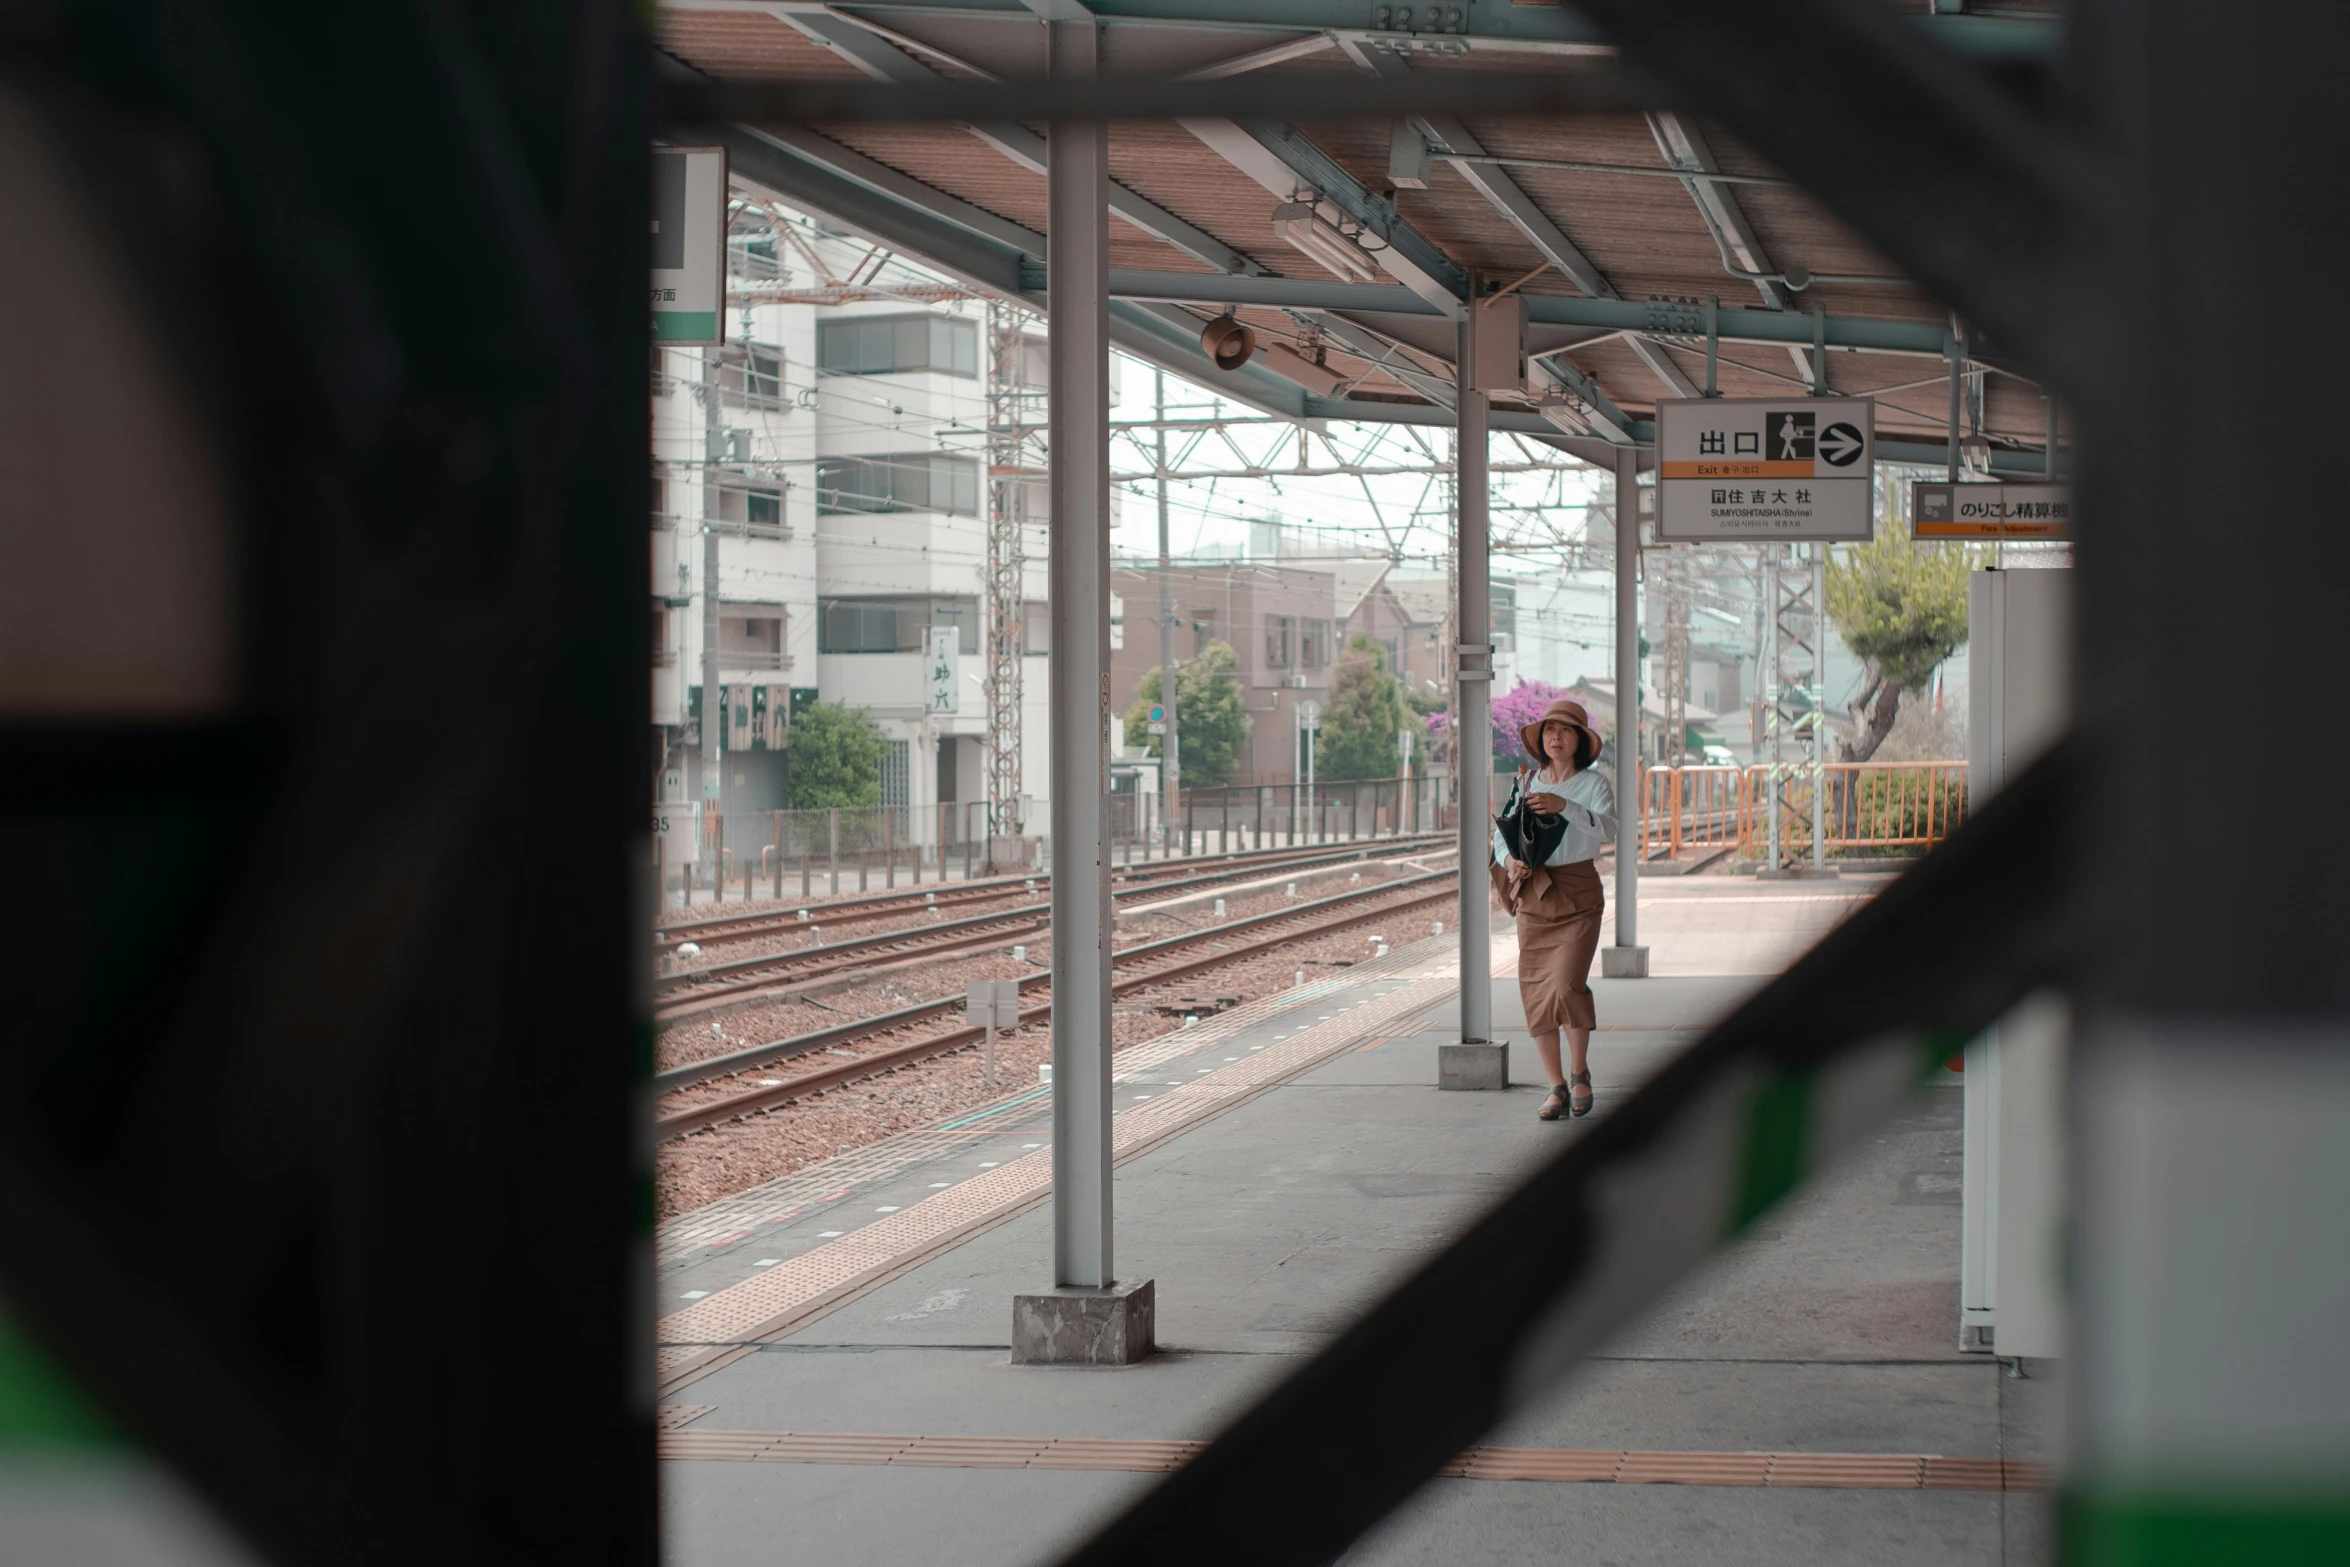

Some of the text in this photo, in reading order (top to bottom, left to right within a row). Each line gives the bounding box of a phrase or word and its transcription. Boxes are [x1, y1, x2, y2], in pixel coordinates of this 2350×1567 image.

[1700, 430, 1759, 455] 出口
[1698, 465, 1717, 475] Exit
[1728, 489, 1812, 504] 住吉大社
[1961, 502, 2070, 518] のりこし精算機
[2004, 525, 2048, 534] Adjustment
